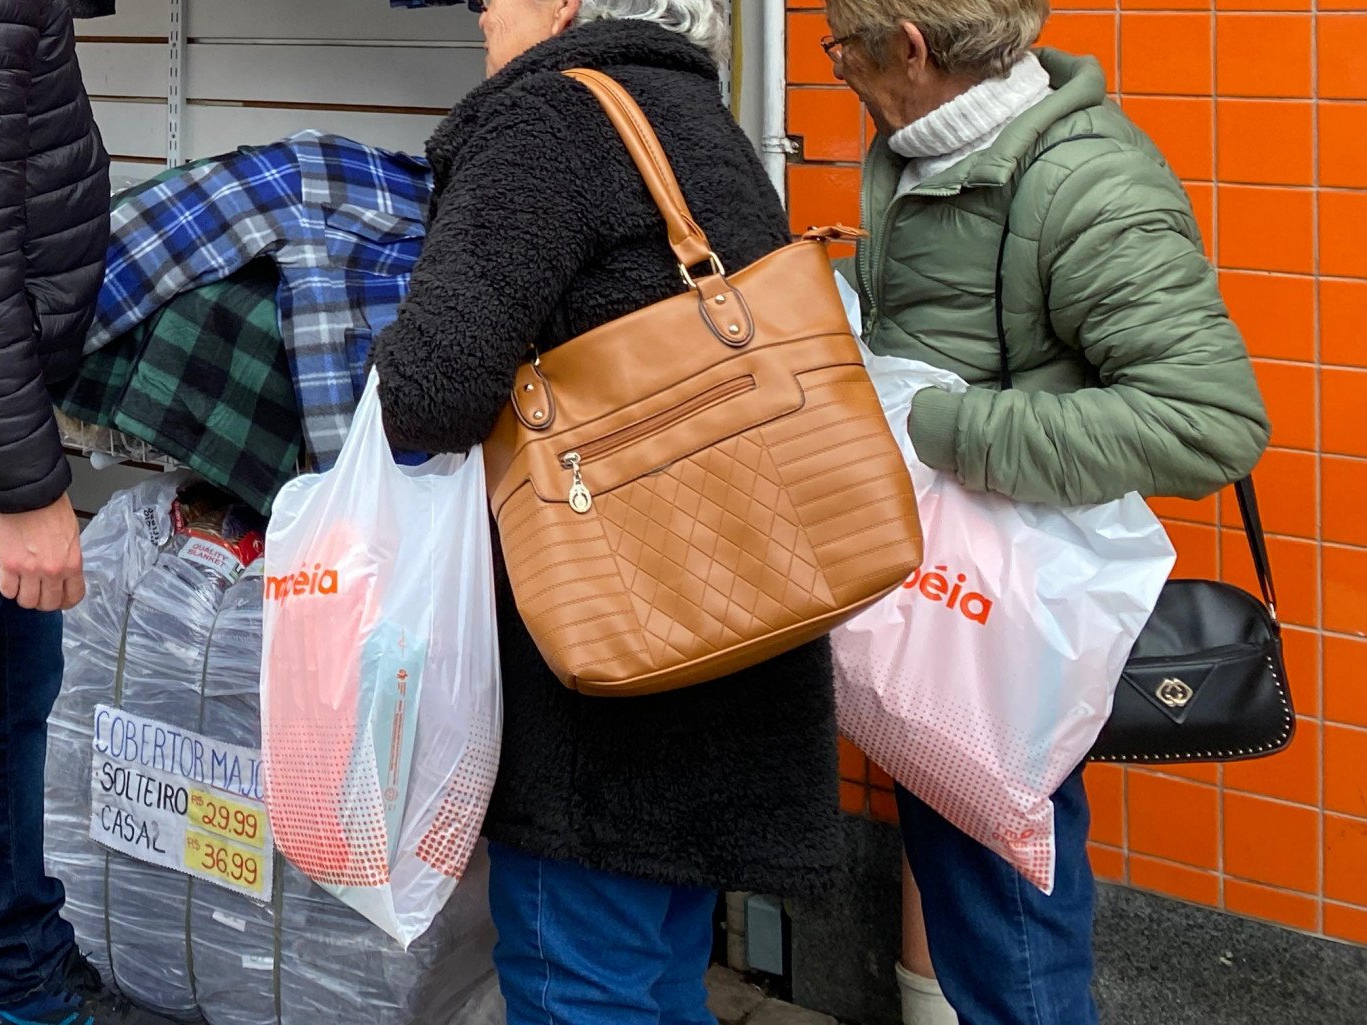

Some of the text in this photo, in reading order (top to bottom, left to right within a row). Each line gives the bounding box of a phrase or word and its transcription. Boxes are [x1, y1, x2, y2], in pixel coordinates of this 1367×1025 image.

[187, 548, 226, 567] BLANKET
[192, 543, 229, 561] QUALITY
[96, 711, 204, 783] COBERTOR
[100, 762, 258, 839] SOLTEIRO R$ 29.99
[101, 805, 258, 884] CASAL R$ 36.99
